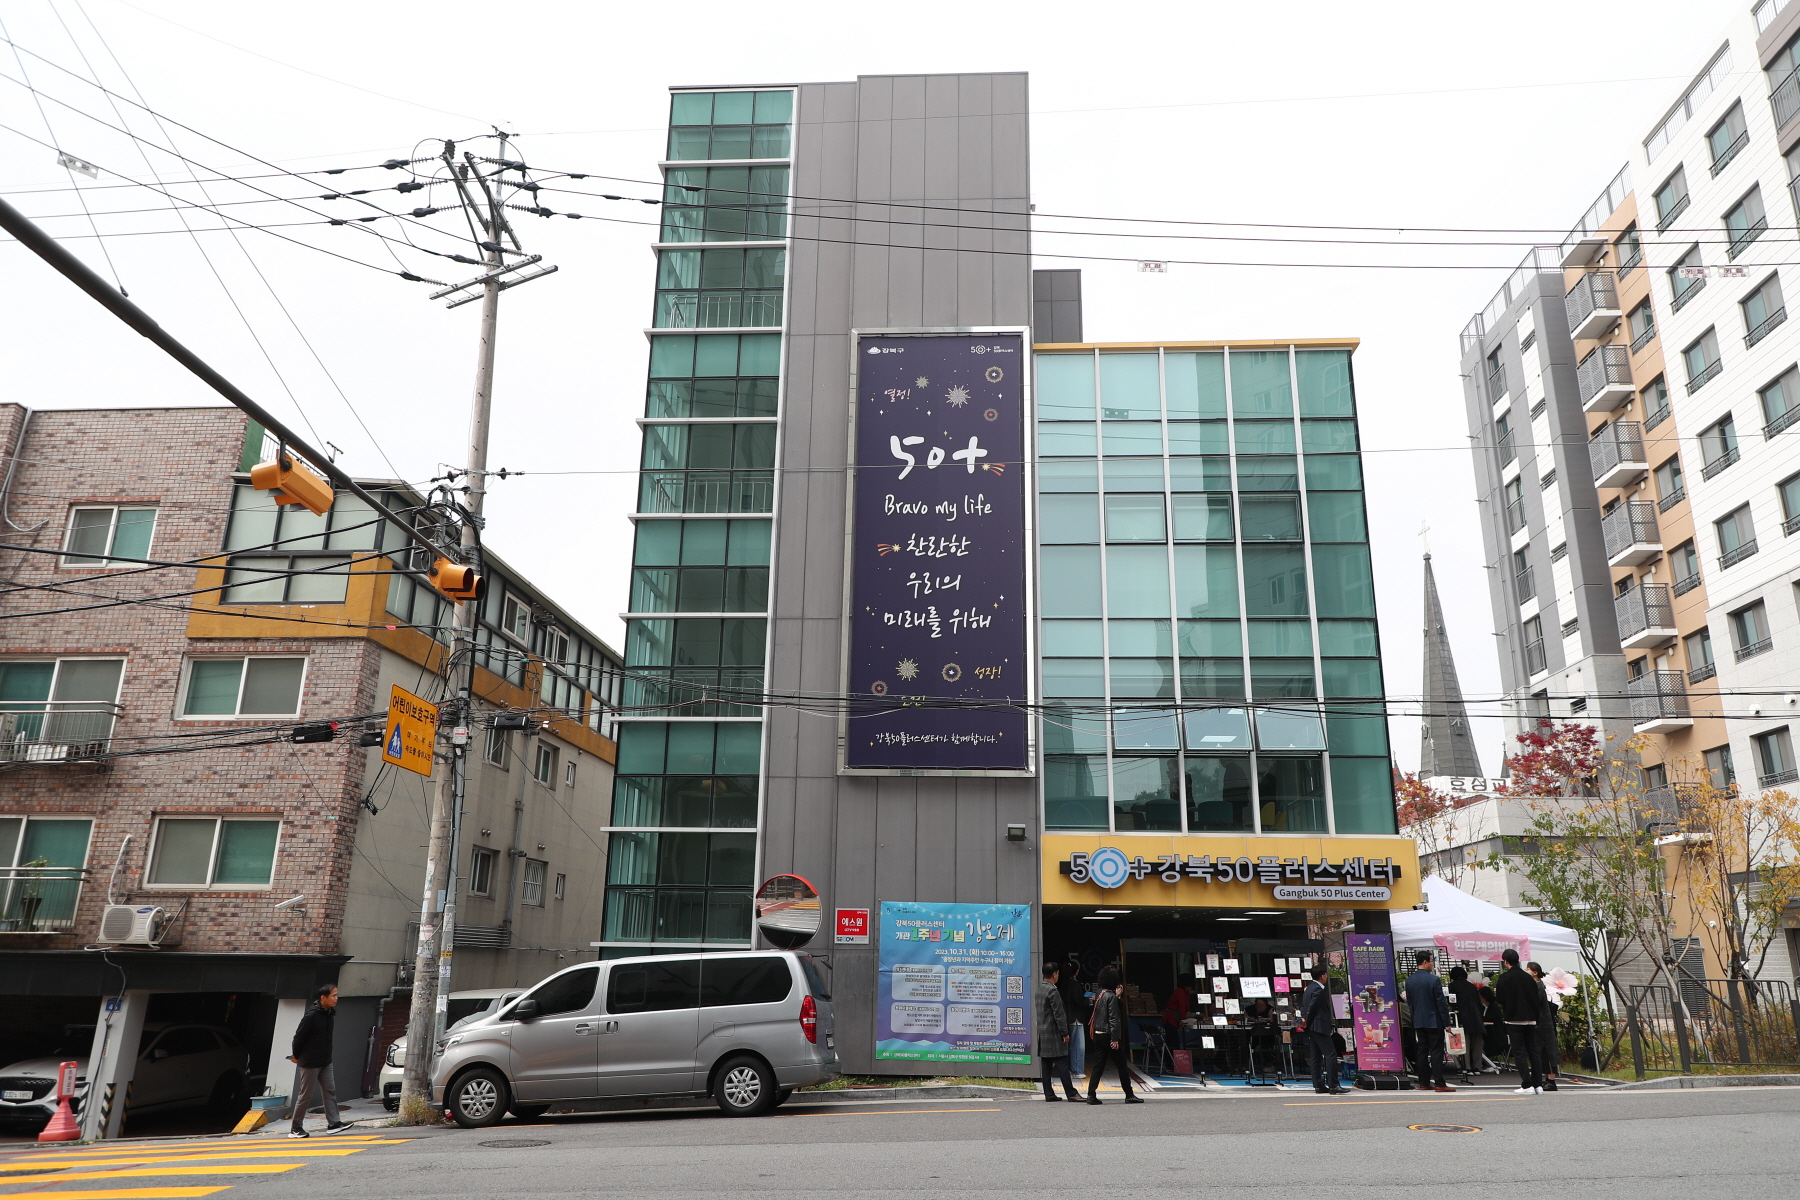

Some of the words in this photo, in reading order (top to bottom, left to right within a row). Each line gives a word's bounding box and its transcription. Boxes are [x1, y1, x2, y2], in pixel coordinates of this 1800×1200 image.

[884, 388, 911, 402] 열정!
[890, 436, 988, 480] 50+
[884, 494, 928, 516] Bravo
[936, 501, 957, 522] my
[964, 494, 992, 516] life
[907, 533, 971, 558] 찬란한
[906, 572, 962, 598] 우리의
[884, 606, 942, 638] 미래를
[949, 607, 992, 634] 위해
[974, 666, 1002, 679] 성장!
[392, 695, 436, 728] 어린이보호구역
[876, 732, 948, 746] 강북50플러스센터가
[950, 732, 998, 746] 함께합니다.
[1158, 854, 1395, 886] 강북50플러스센터
[1279, 888, 1318, 900] Gangbuk
[1321, 889, 1332, 898] 50
[1334, 889, 1354, 898] Plus
[1356, 889, 1386, 898] Center
[842, 918, 862, 926] 에스원
[895, 920, 944, 928] 강북50플러스센터
[966, 918, 1014, 942] 강오제
[895, 931, 910, 940] 개관
[910, 928, 942, 942] 1주년
[942, 929, 966, 942] 기념
